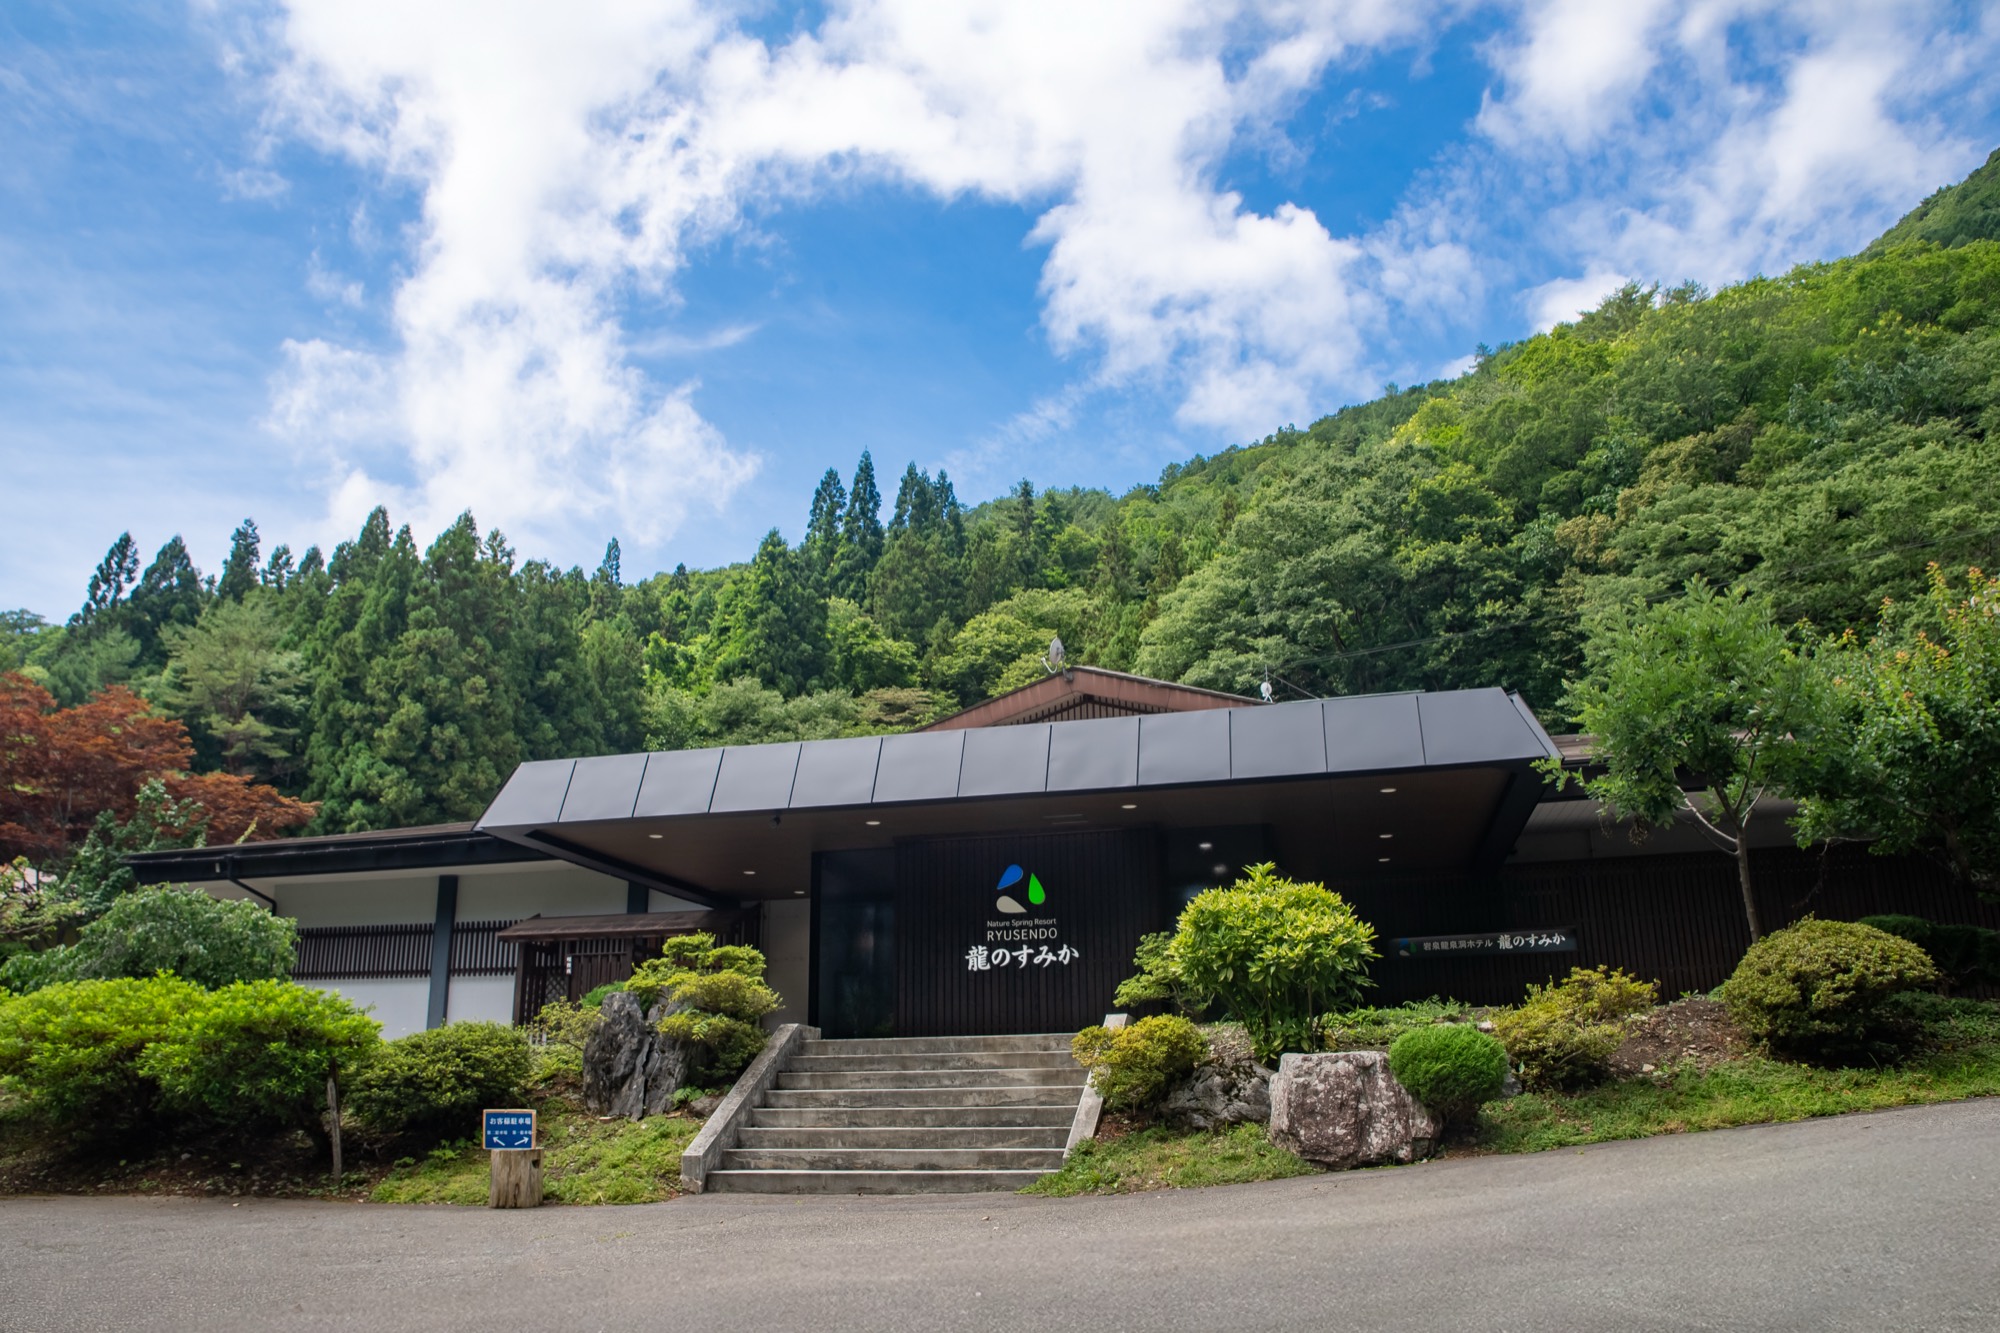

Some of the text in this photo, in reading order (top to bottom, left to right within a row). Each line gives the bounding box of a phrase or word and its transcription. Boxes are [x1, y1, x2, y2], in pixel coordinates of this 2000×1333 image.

[986, 918, 1057, 928] Nature Spring Resort
[986, 927, 1058, 941] RYUSENDO
[1497, 932, 1566, 950] 龍のすみか
[965, 943, 1080, 972] 龍のすみか
